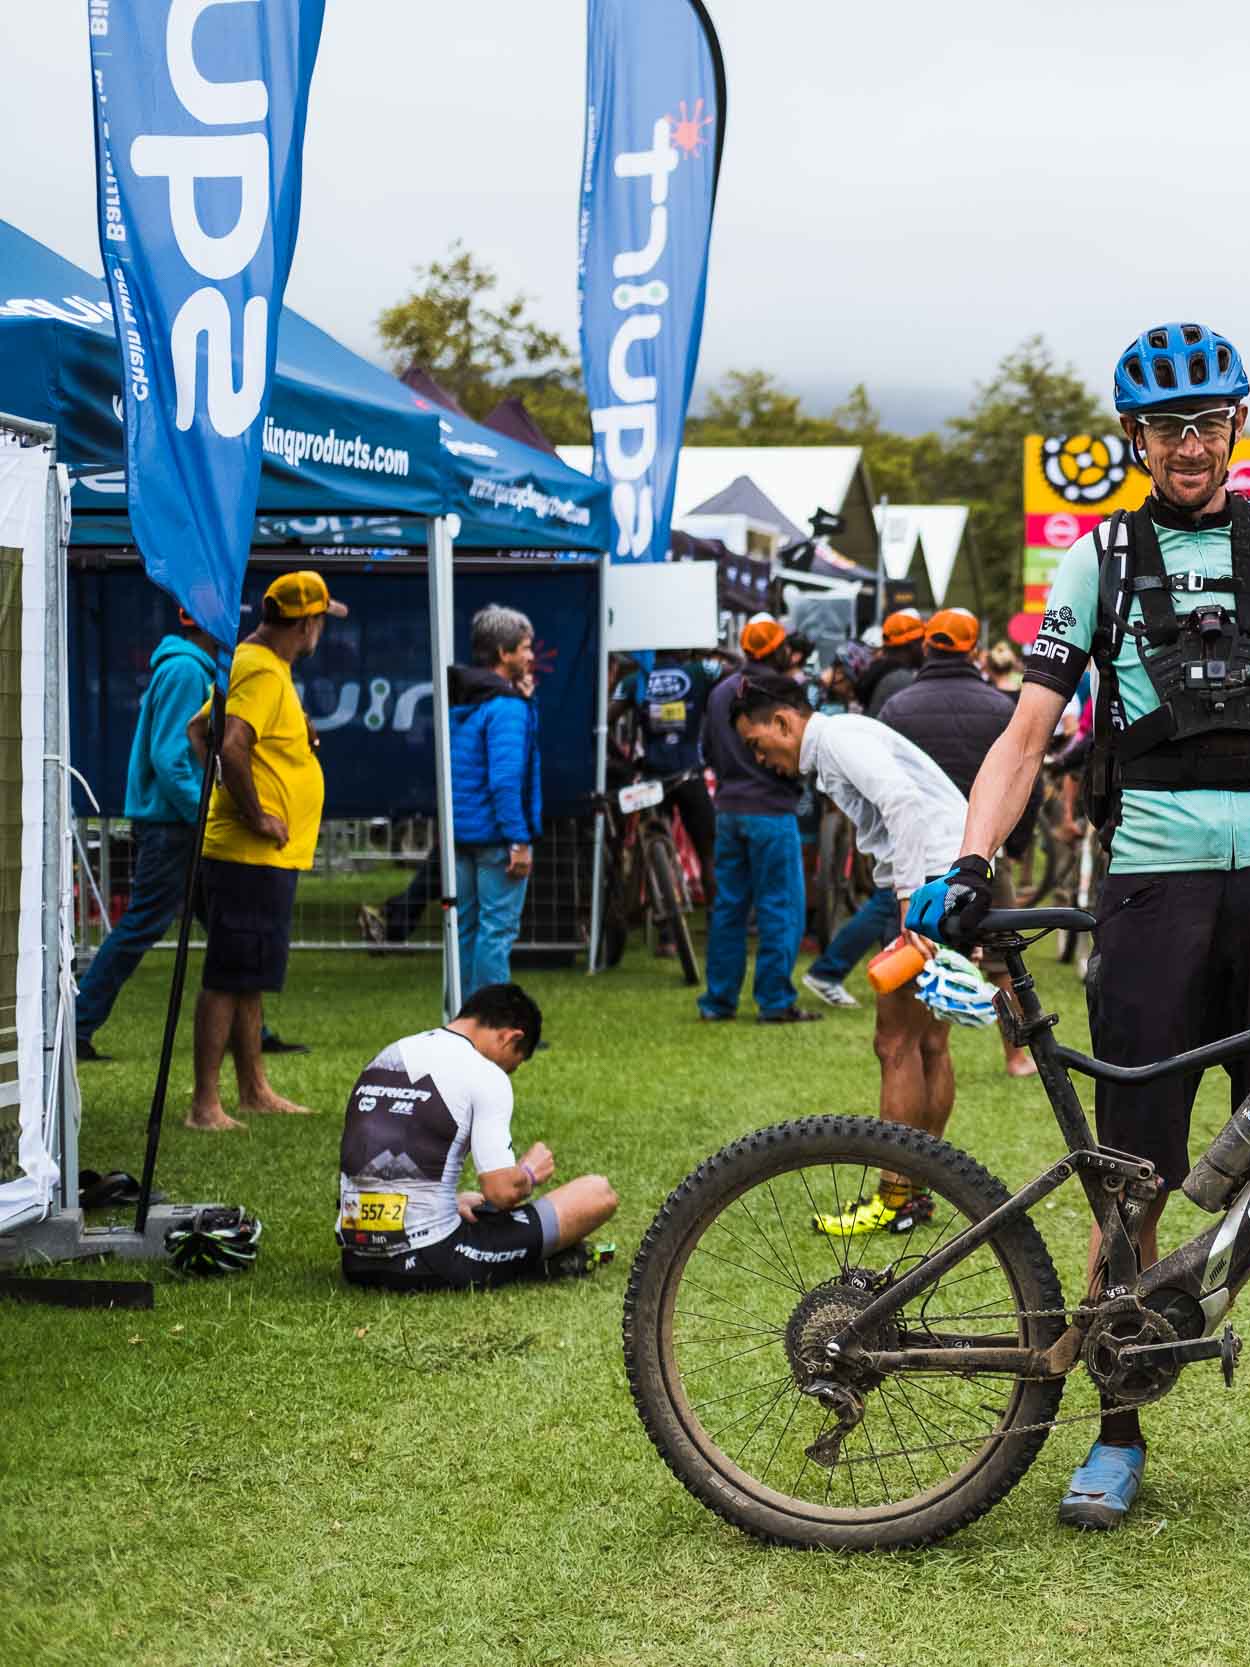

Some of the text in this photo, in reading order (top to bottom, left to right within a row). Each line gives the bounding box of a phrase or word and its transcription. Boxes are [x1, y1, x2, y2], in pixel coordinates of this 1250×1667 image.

[356, 1084, 432, 1103] MERIDA
[360, 1203, 401, 1221] 557-2
[454, 1243, 528, 1263] MERIDA
